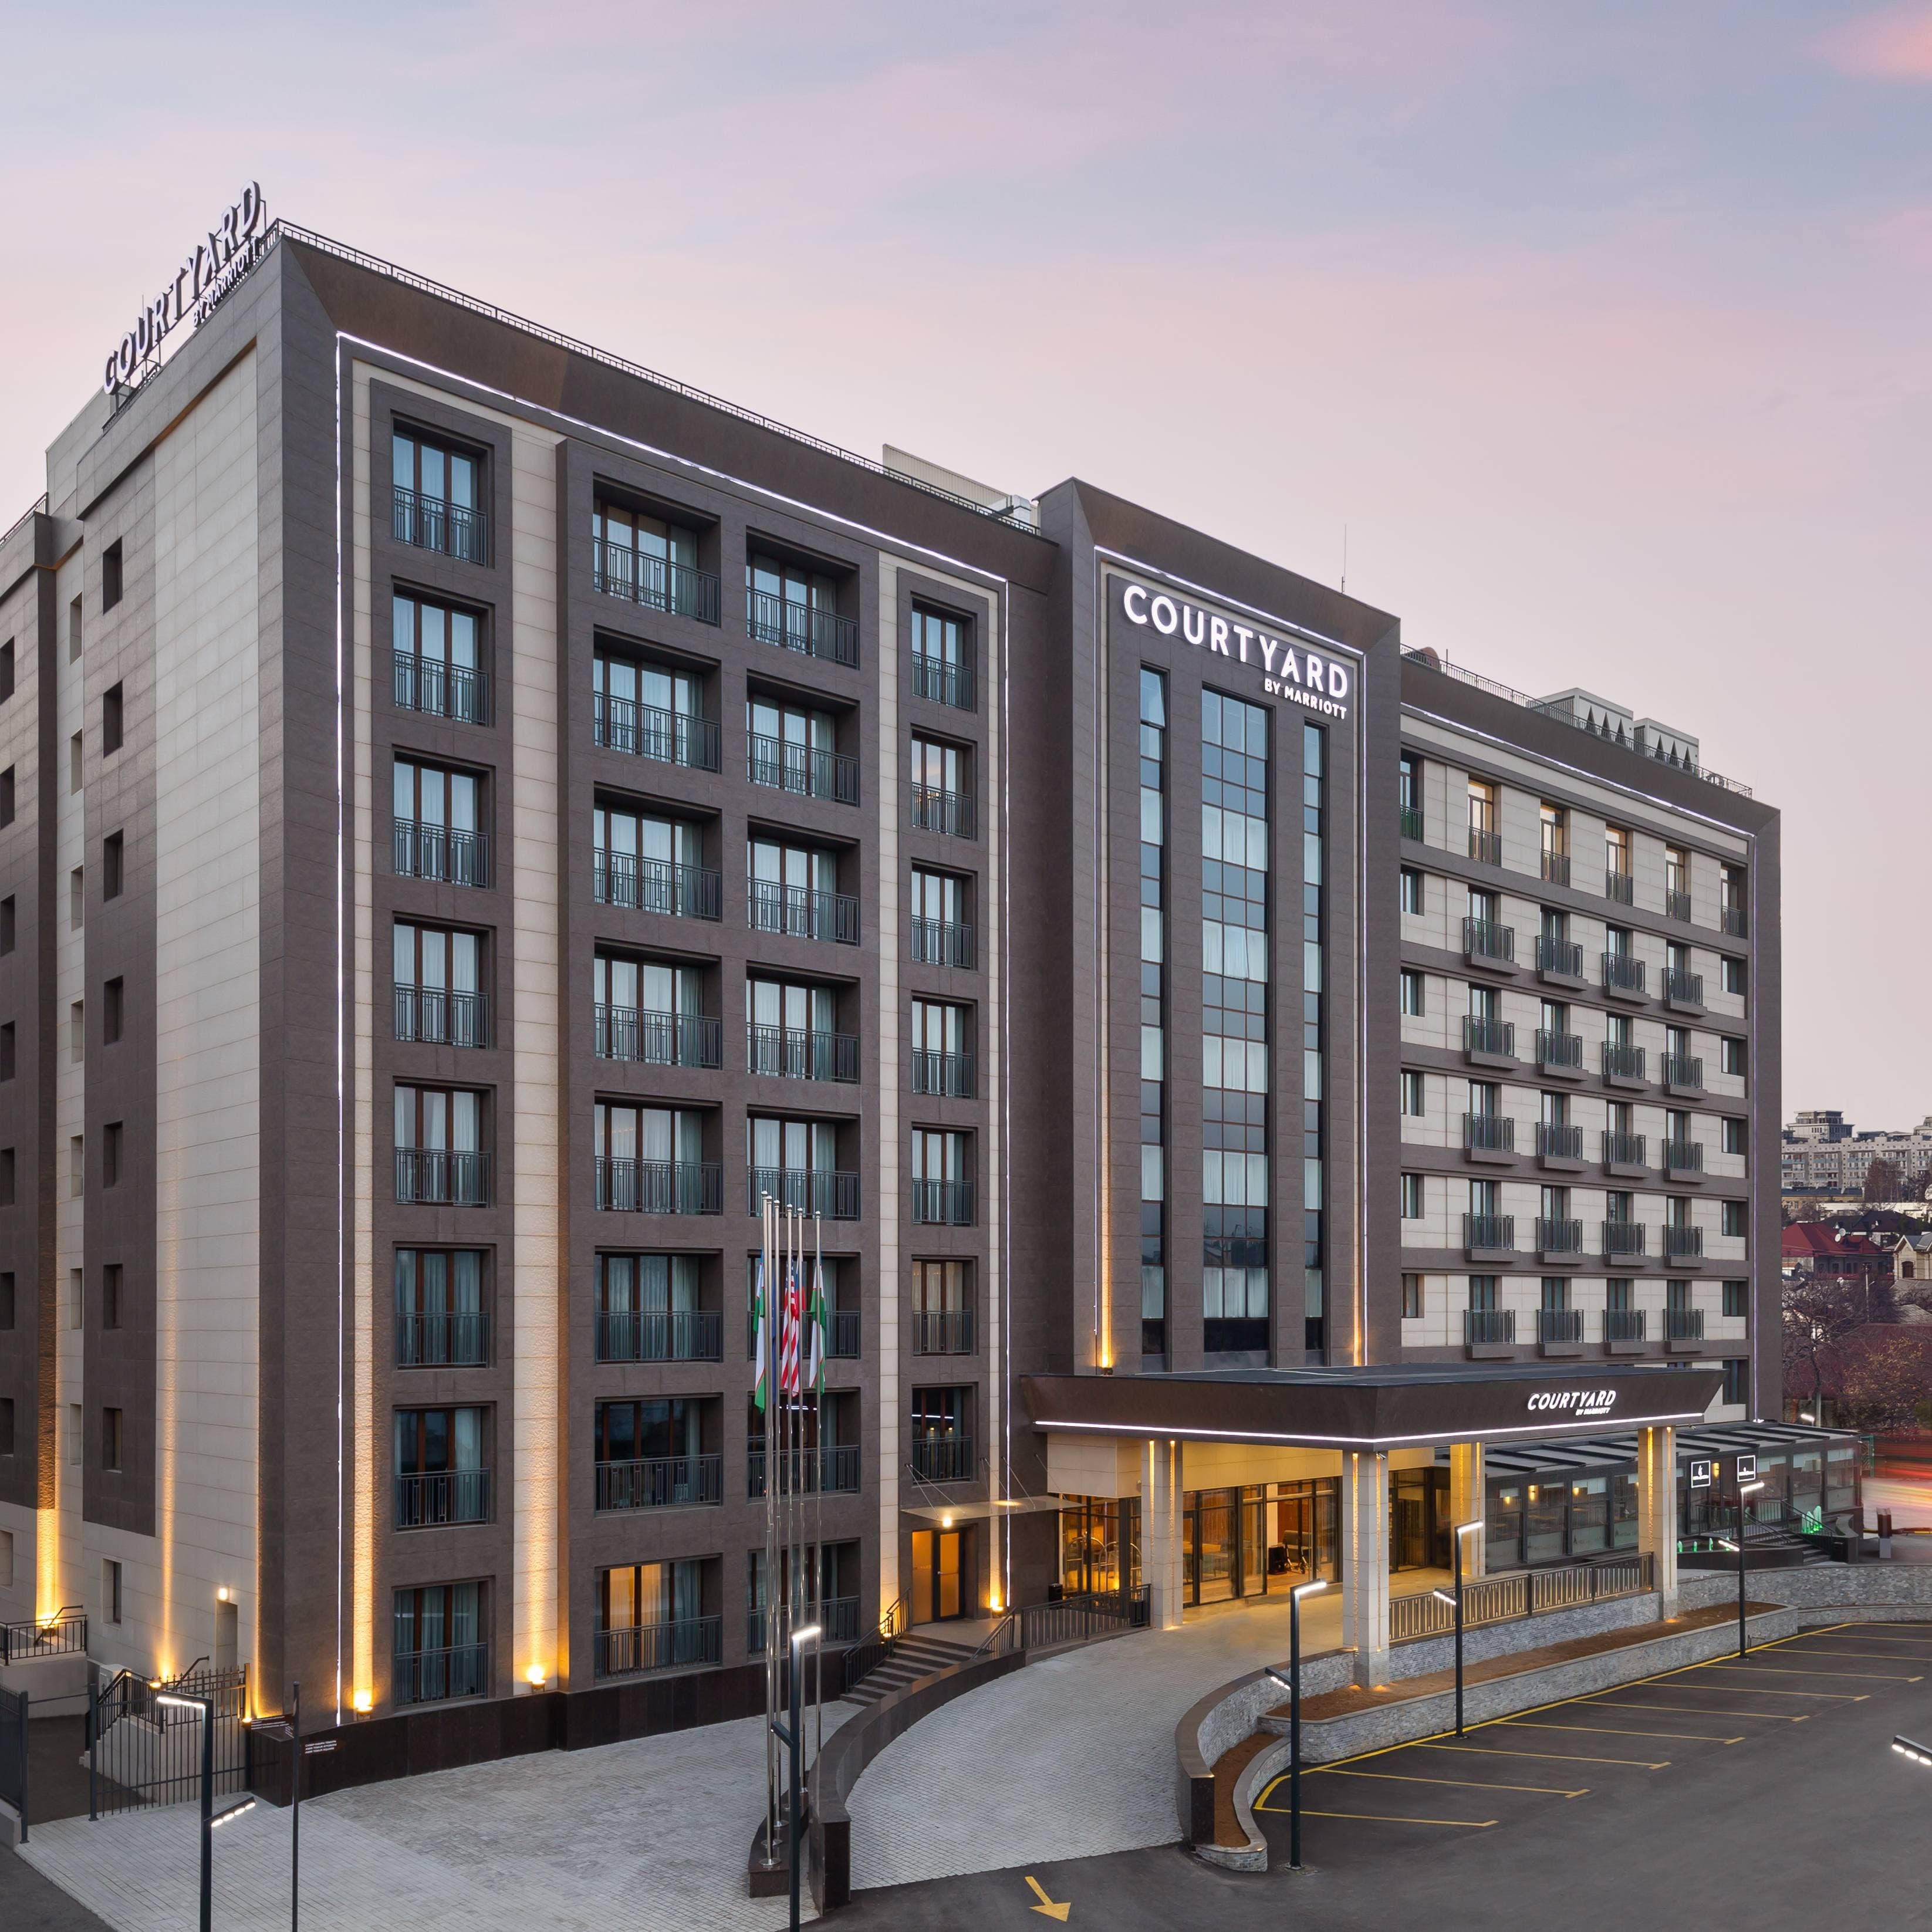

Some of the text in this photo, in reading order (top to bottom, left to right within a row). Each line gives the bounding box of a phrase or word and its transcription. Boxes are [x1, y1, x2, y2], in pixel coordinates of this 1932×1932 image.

[103, 179, 261, 395] COURTYARD
[205, 236, 257, 312] MARRIOTT
[1123, 585, 1348, 698] COURTYARD
[1264, 677, 1347, 720] BY MARRIOTT
[1527, 1390, 1616, 1411] COURTYARD
